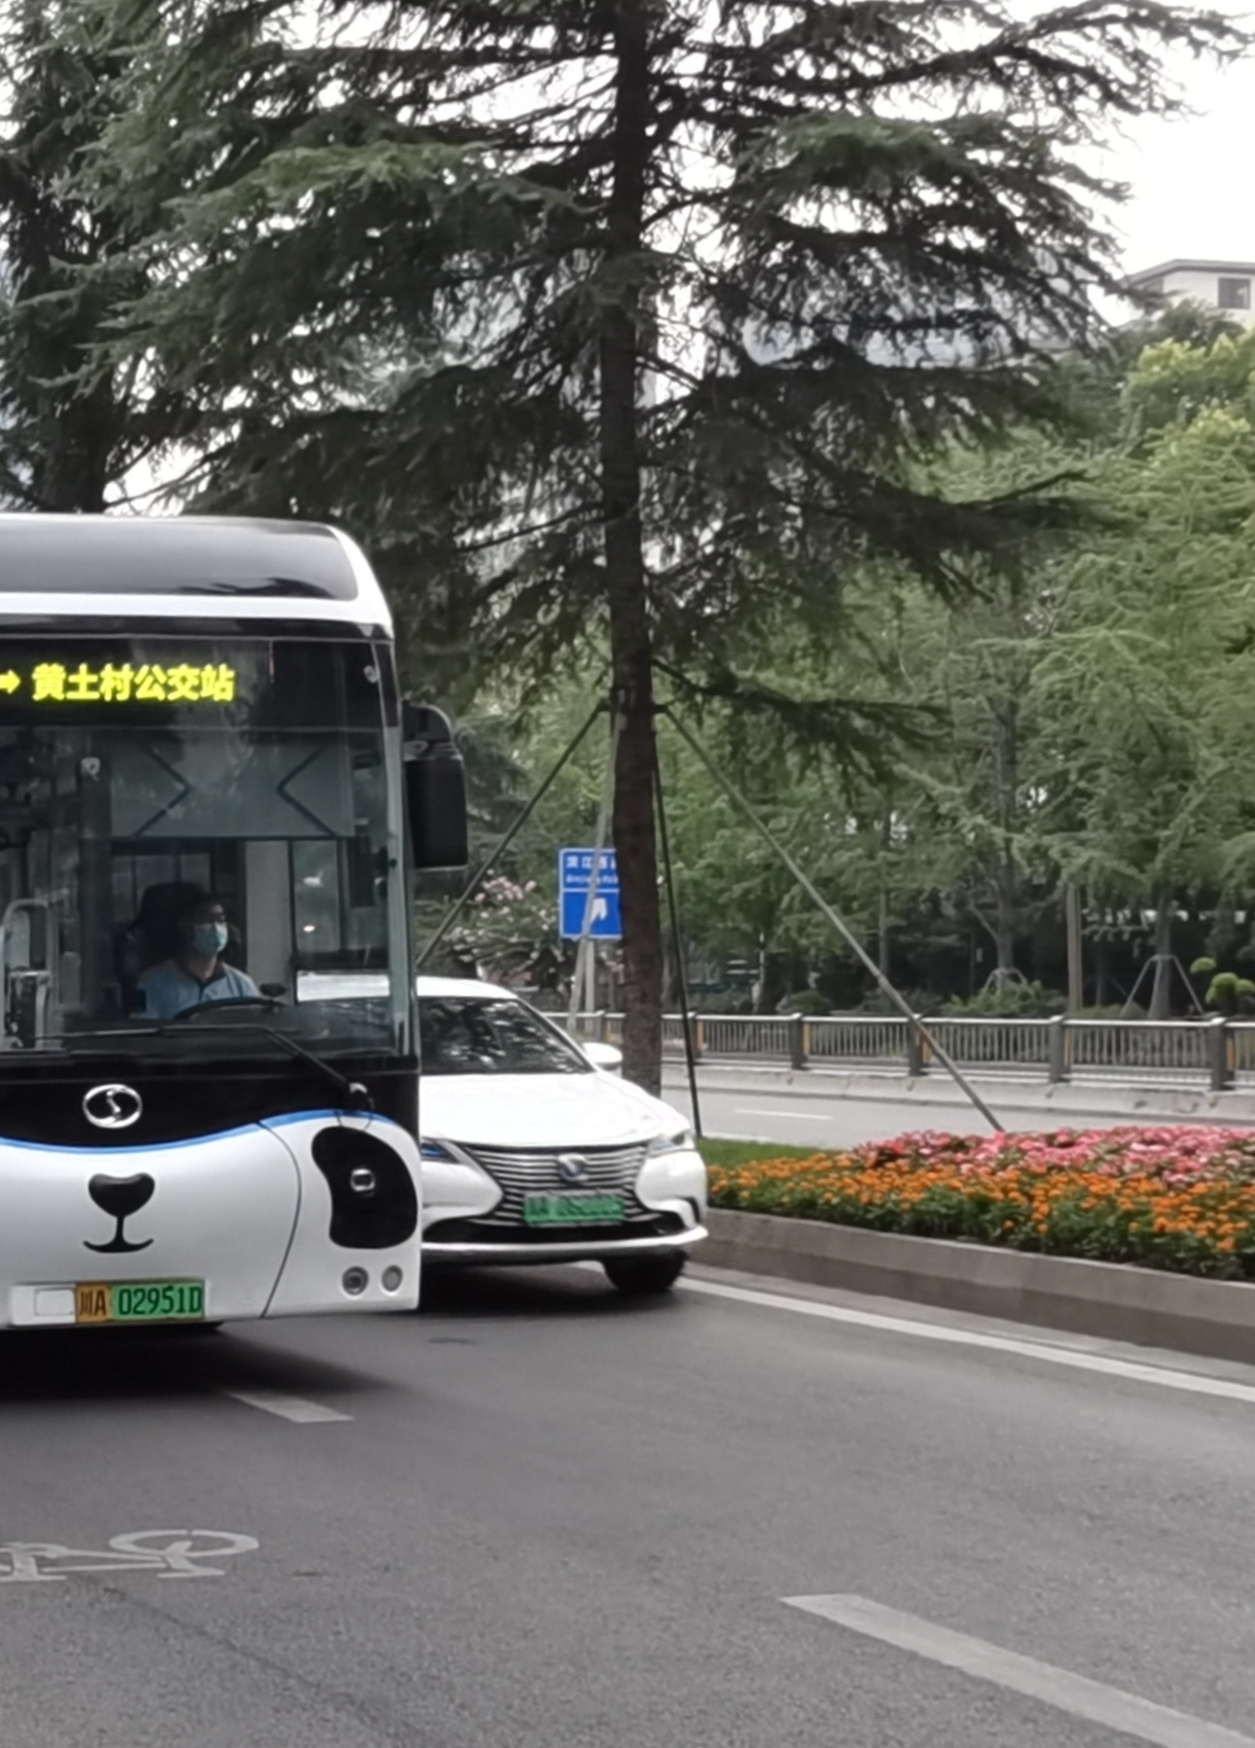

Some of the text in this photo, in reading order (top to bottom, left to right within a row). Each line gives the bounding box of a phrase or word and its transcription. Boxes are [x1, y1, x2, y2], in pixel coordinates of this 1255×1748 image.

[32, 662, 236, 701] 黄土村公交站
[118, 1285, 203, 1316] 02951D
